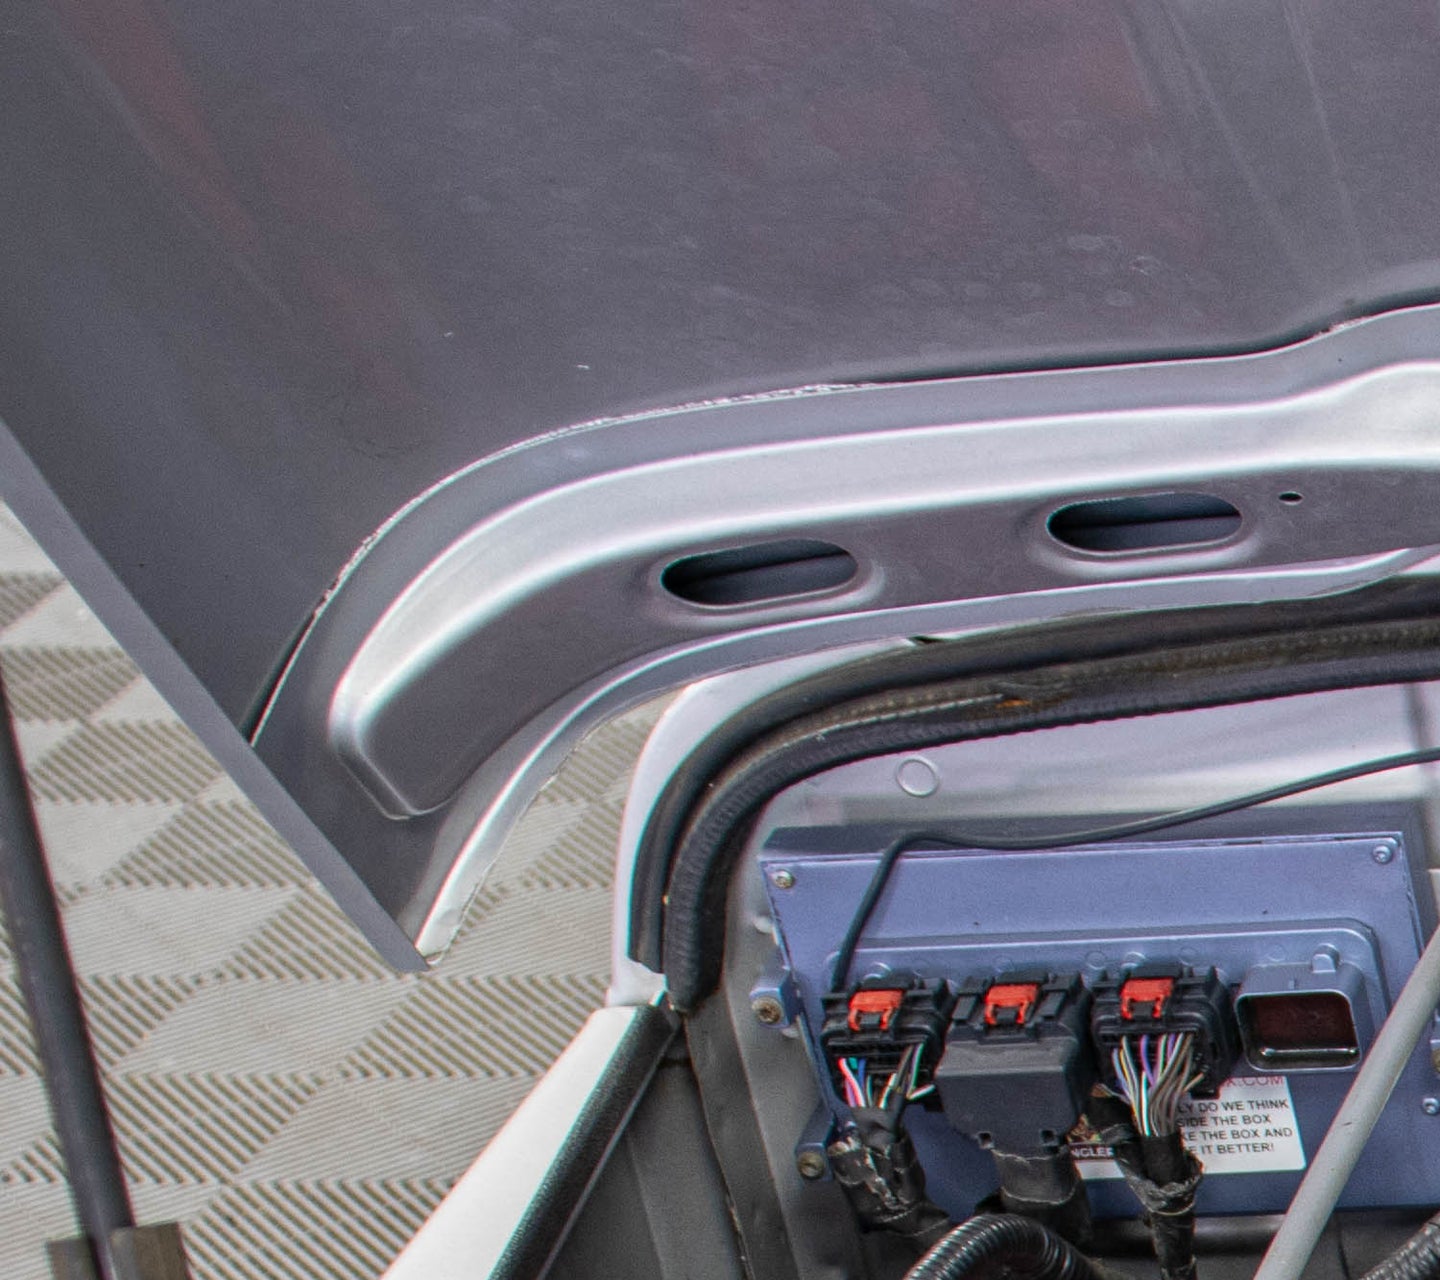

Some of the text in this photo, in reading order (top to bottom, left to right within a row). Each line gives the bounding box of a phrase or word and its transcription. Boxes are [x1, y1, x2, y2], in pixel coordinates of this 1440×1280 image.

[1199, 1101, 1219, 1112] DO
[1221, 1100, 1244, 1111] WE
[1248, 1099, 1289, 1110] THINK
[1211, 1115, 1239, 1126] THE
[1242, 1115, 1271, 1125] BOX
[1202, 1129, 1228, 1141] THE
[1231, 1128, 1260, 1139] BOX
[1264, 1127, 1293, 1138] AND
[1201, 1144, 1213, 1155] IT
[1216, 1143, 1275, 1155] BETTER!
